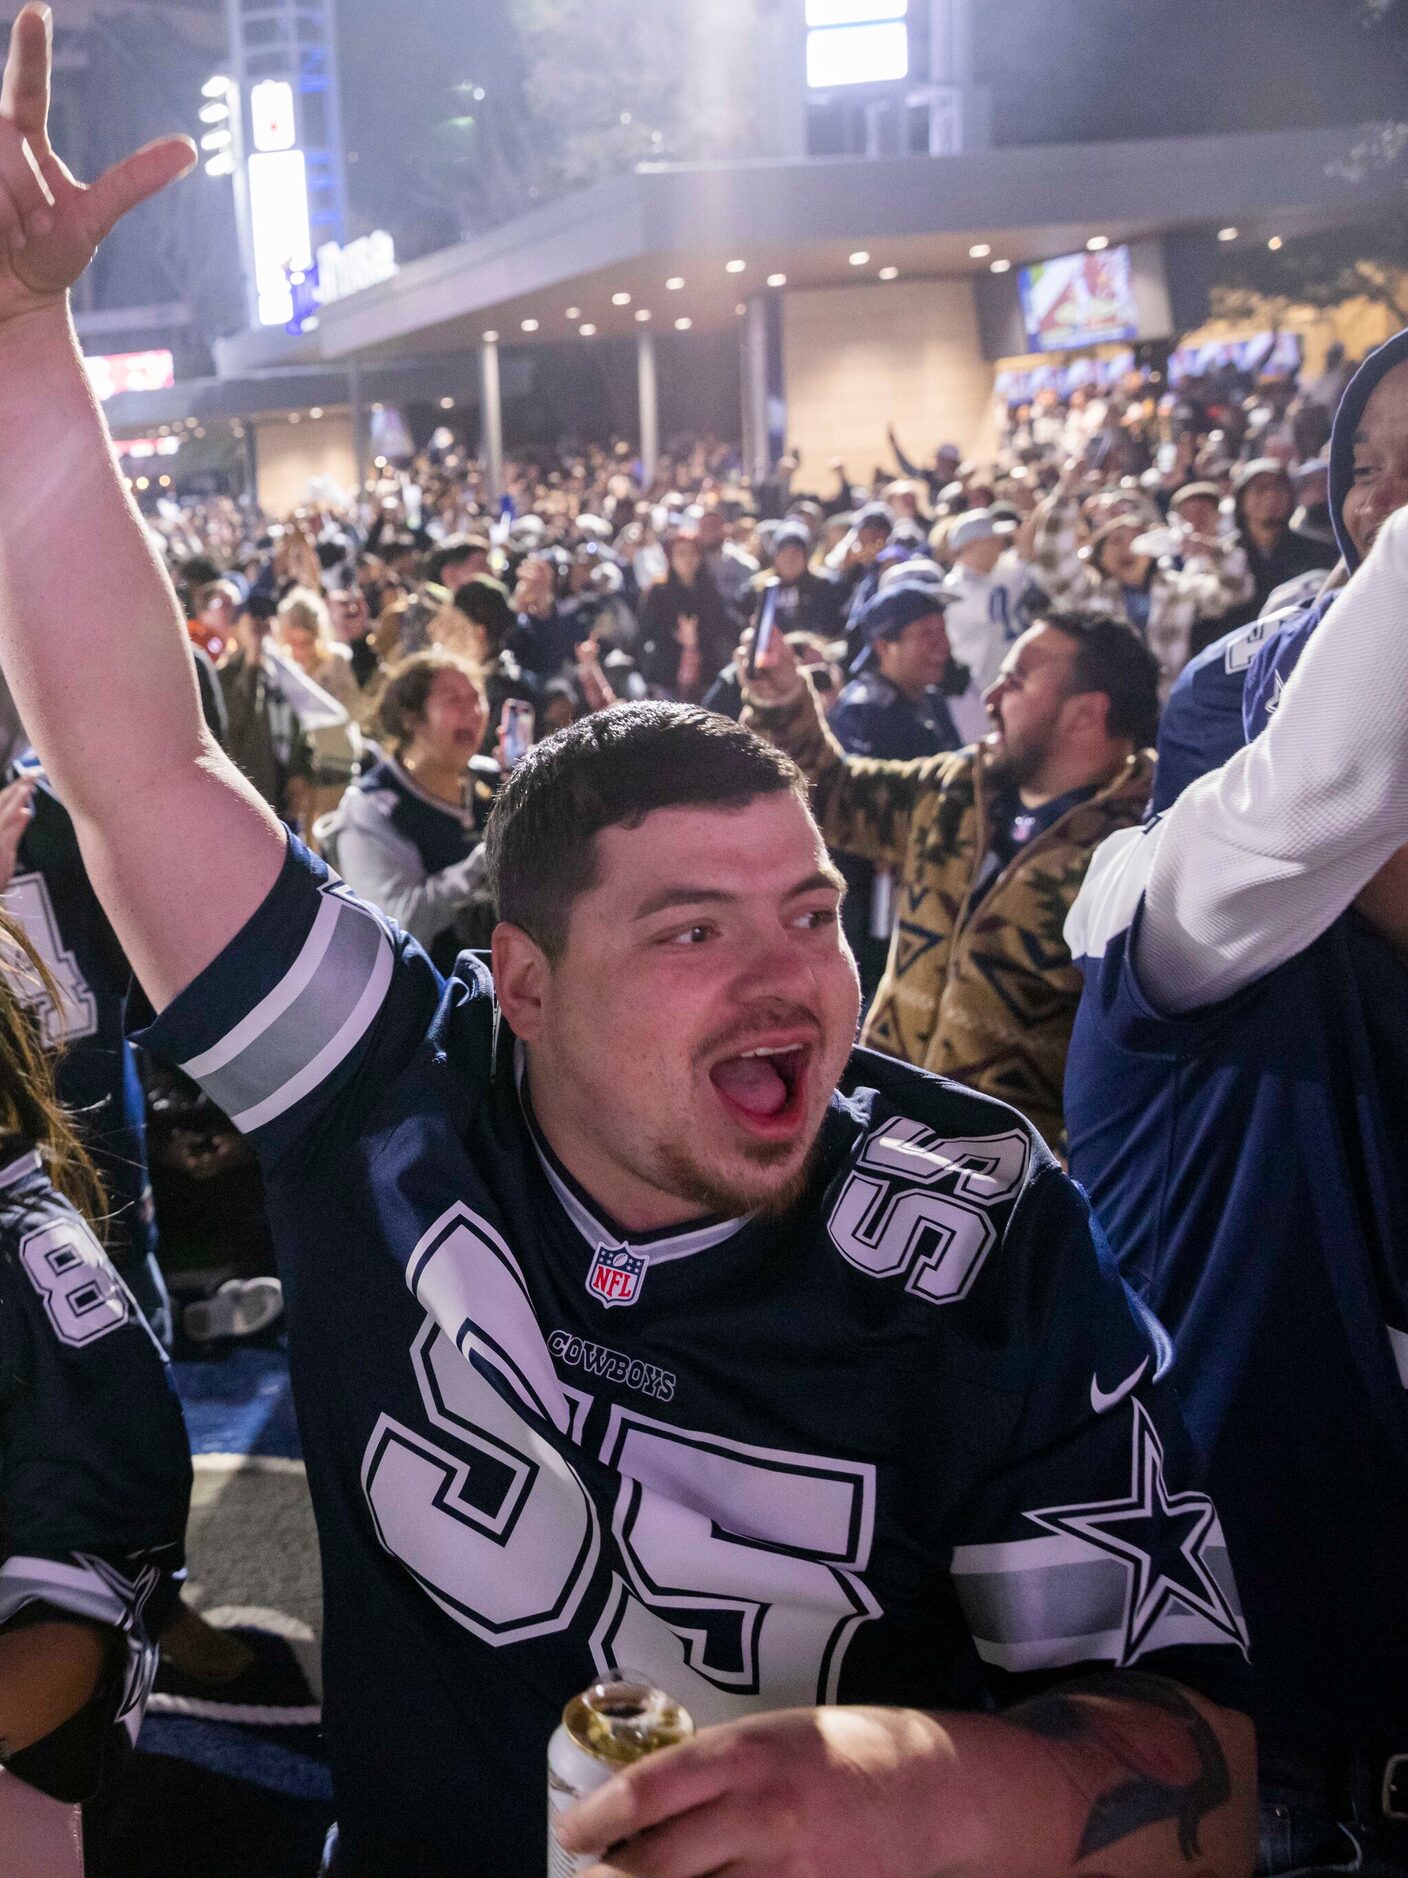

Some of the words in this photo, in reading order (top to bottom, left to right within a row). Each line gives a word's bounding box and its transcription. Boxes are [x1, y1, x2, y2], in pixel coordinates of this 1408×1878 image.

[827, 1115, 1031, 1305] 55
[593, 1265, 633, 1298] NFL
[546, 1329, 676, 1402] COWBOYS
[361, 1200, 884, 1706] 55
